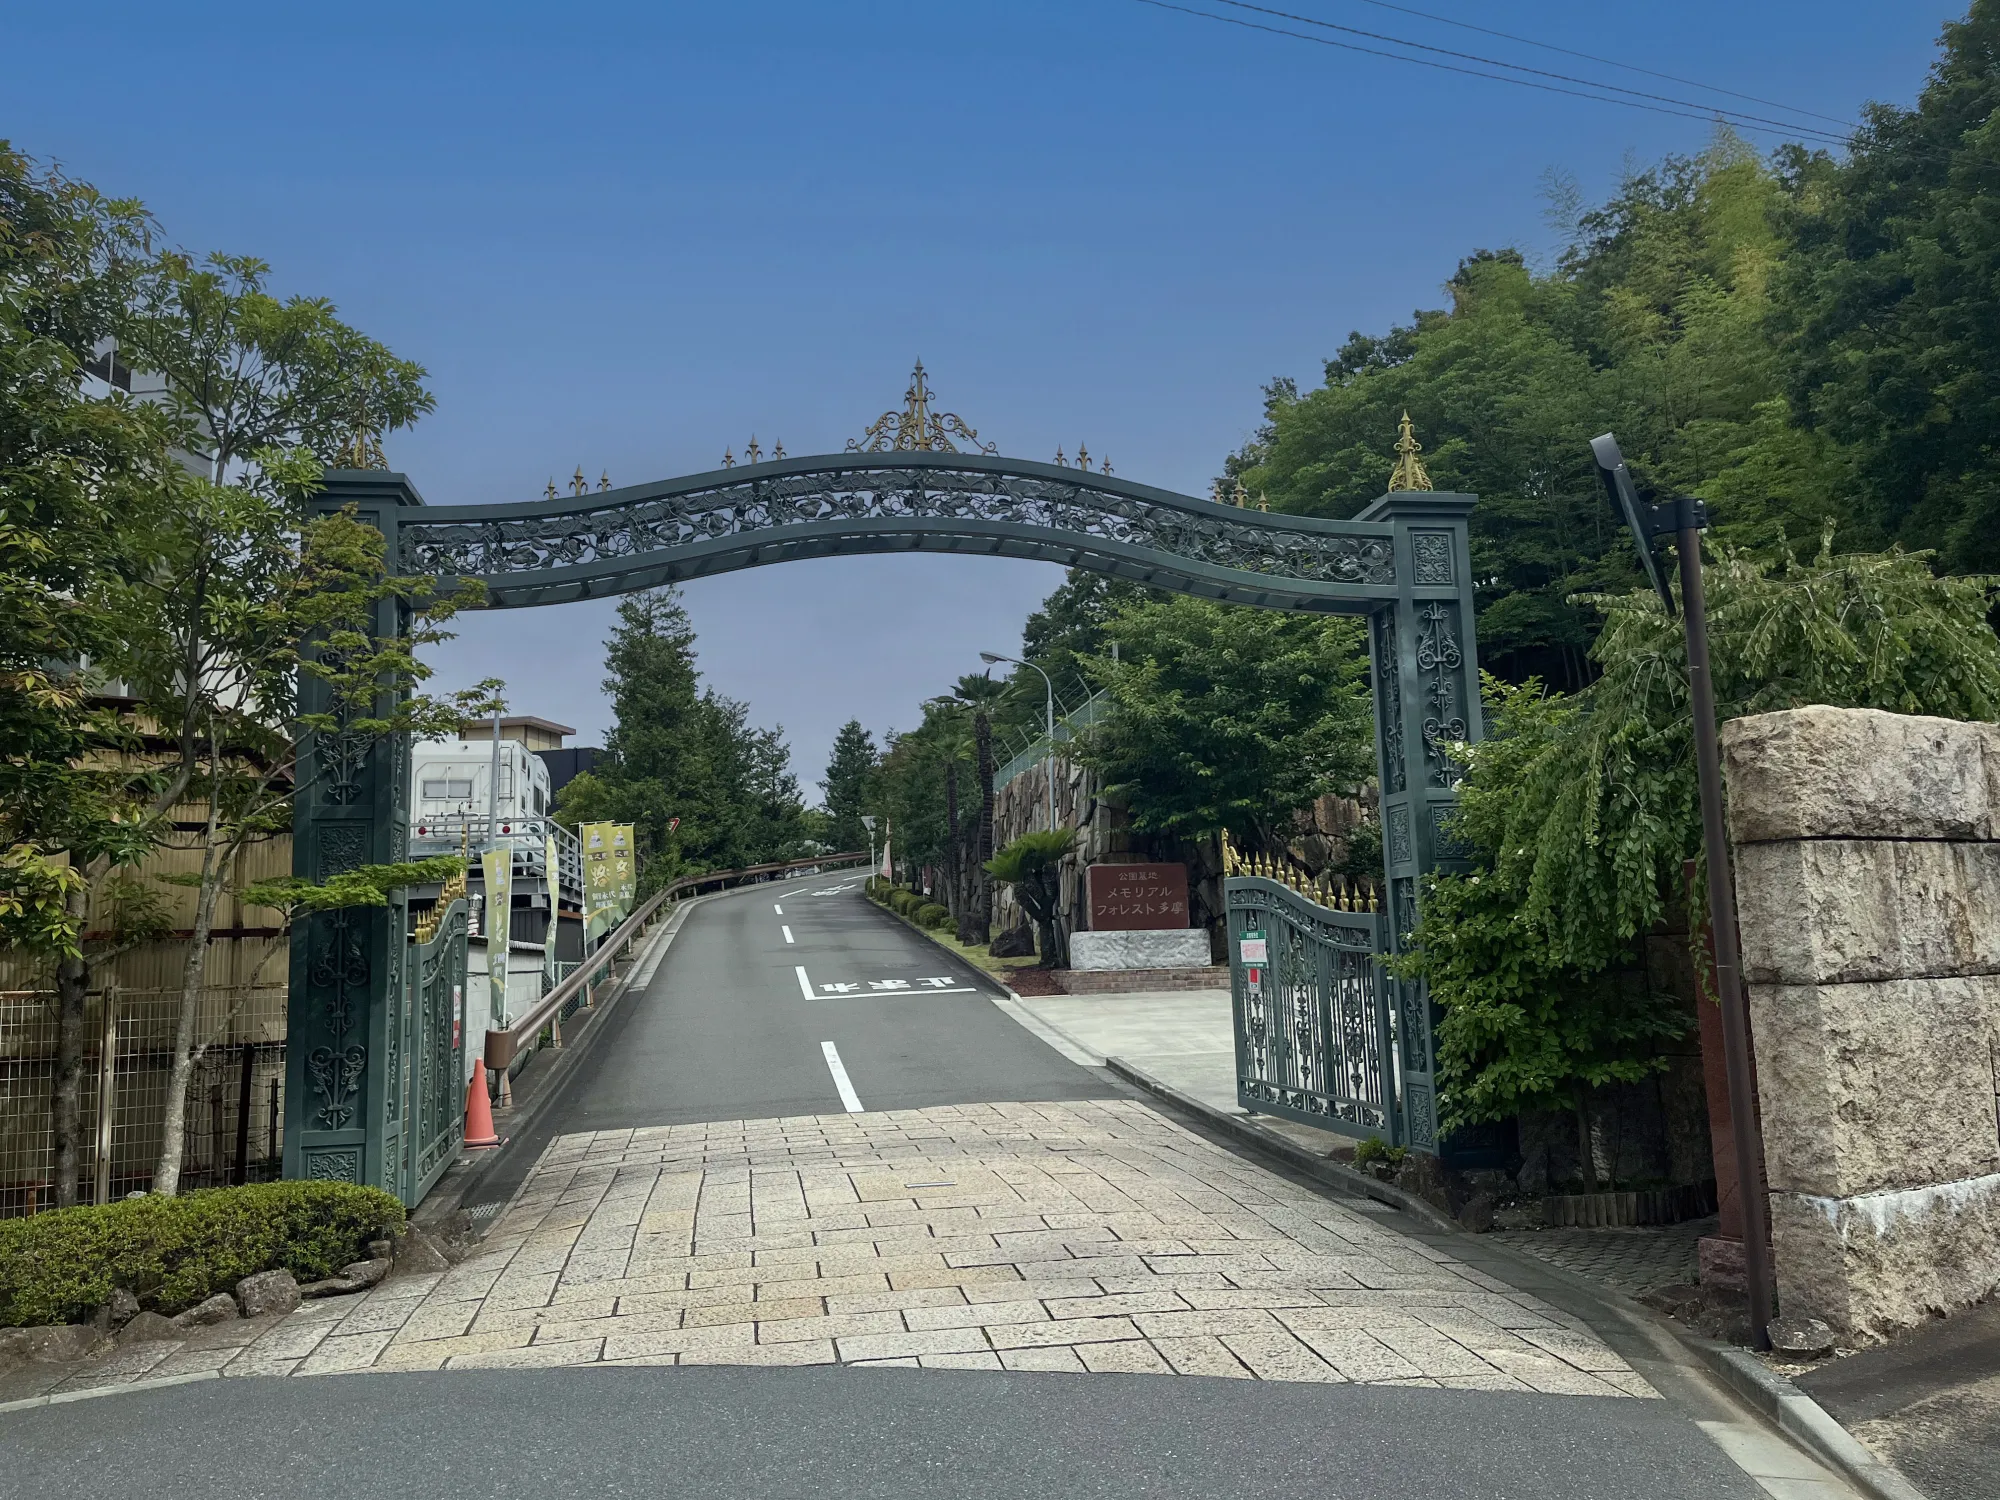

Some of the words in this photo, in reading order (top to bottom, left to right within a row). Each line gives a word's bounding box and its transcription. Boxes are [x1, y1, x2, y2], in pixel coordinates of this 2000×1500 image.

[1119, 871, 1158, 881] 公園墓地
[1107, 886, 1173, 899] メモリアル
[1097, 901, 1185, 916] フォレスト多摩
[819, 976, 956, 993] 止まれ
